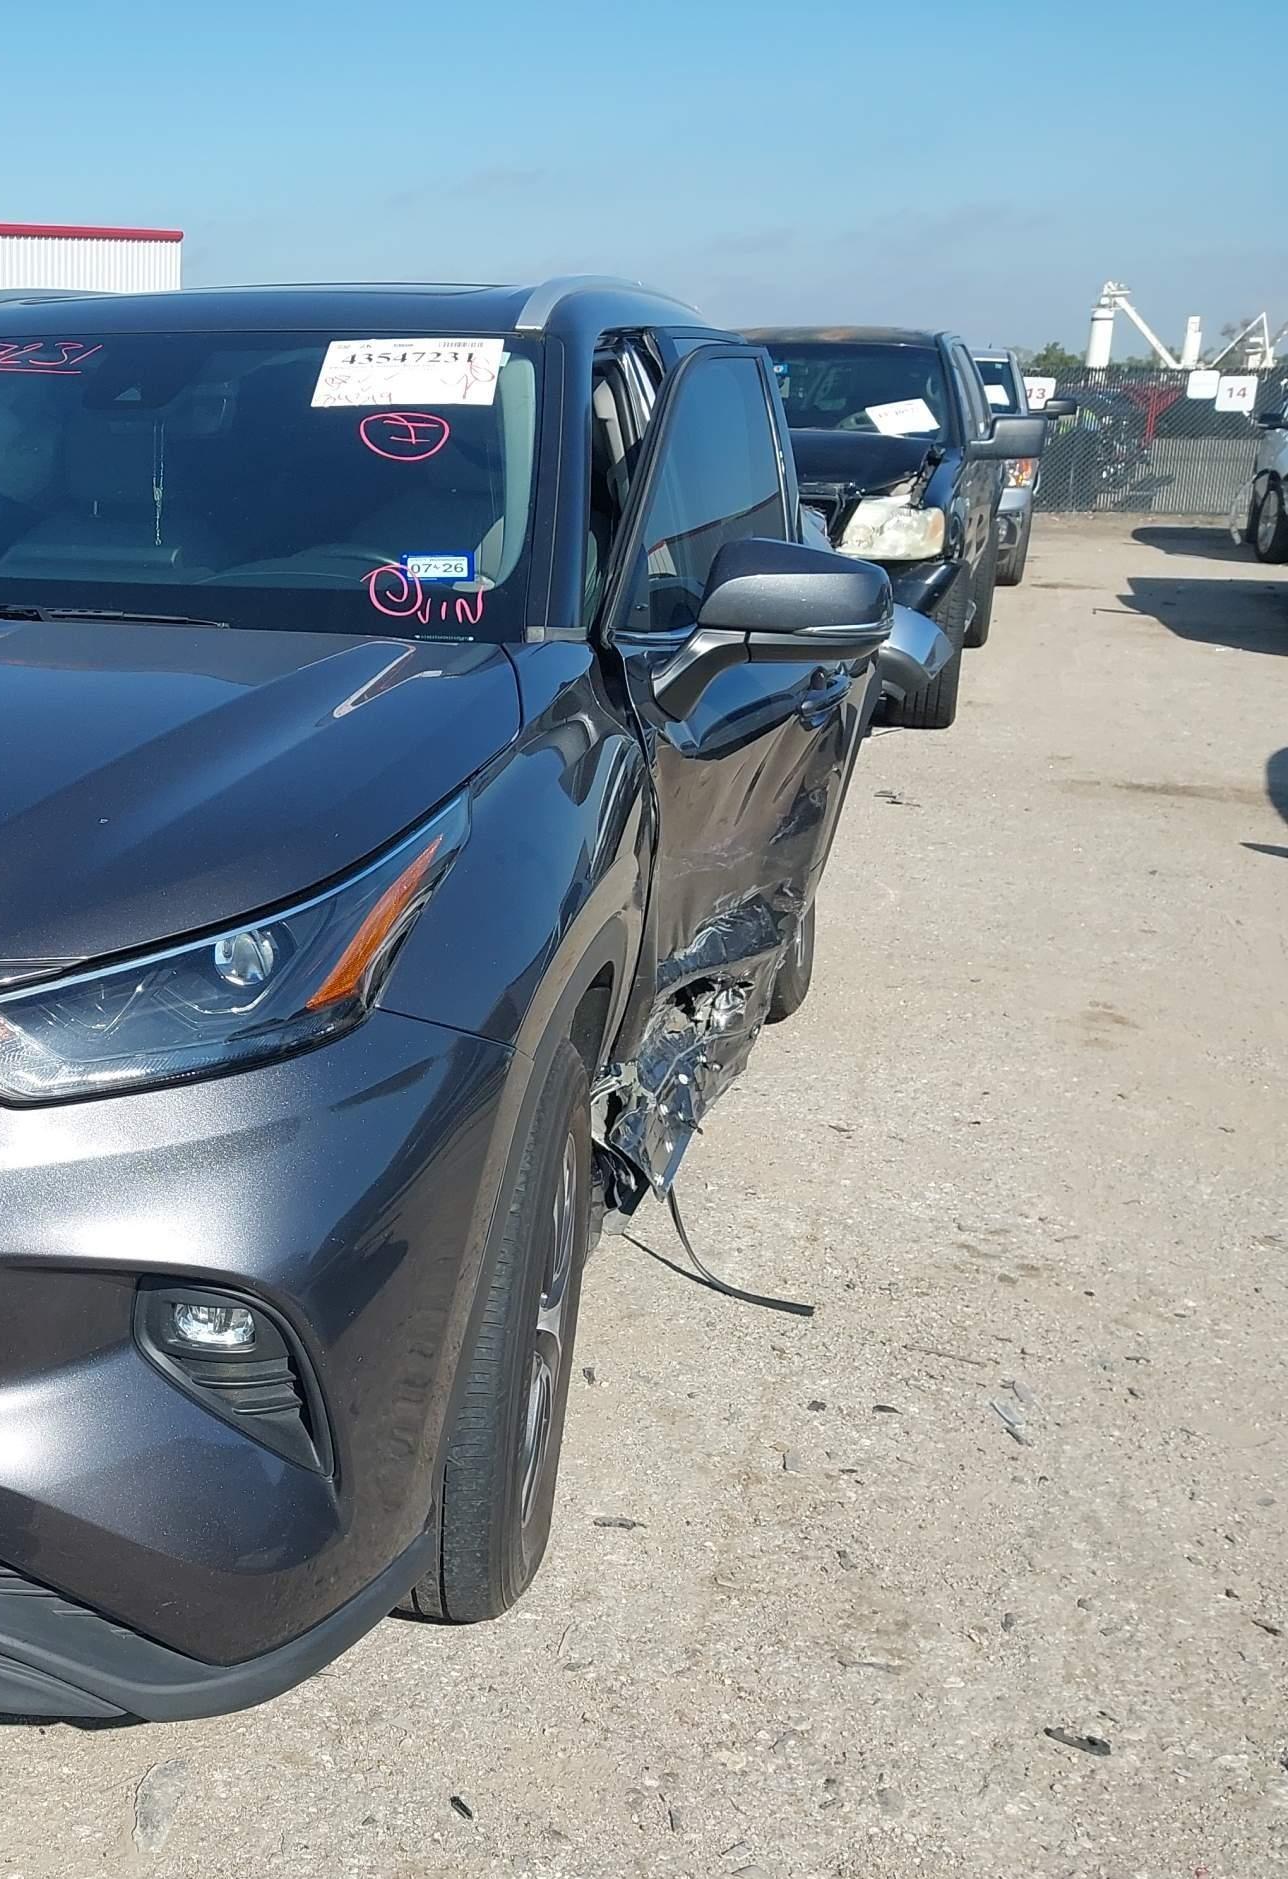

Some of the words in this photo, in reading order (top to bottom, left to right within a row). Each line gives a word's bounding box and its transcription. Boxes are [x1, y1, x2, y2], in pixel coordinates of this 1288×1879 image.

[341, 351, 474, 365] 43547231
[1026, 388, 1046, 399] 13
[1226, 387, 1247, 398] 14
